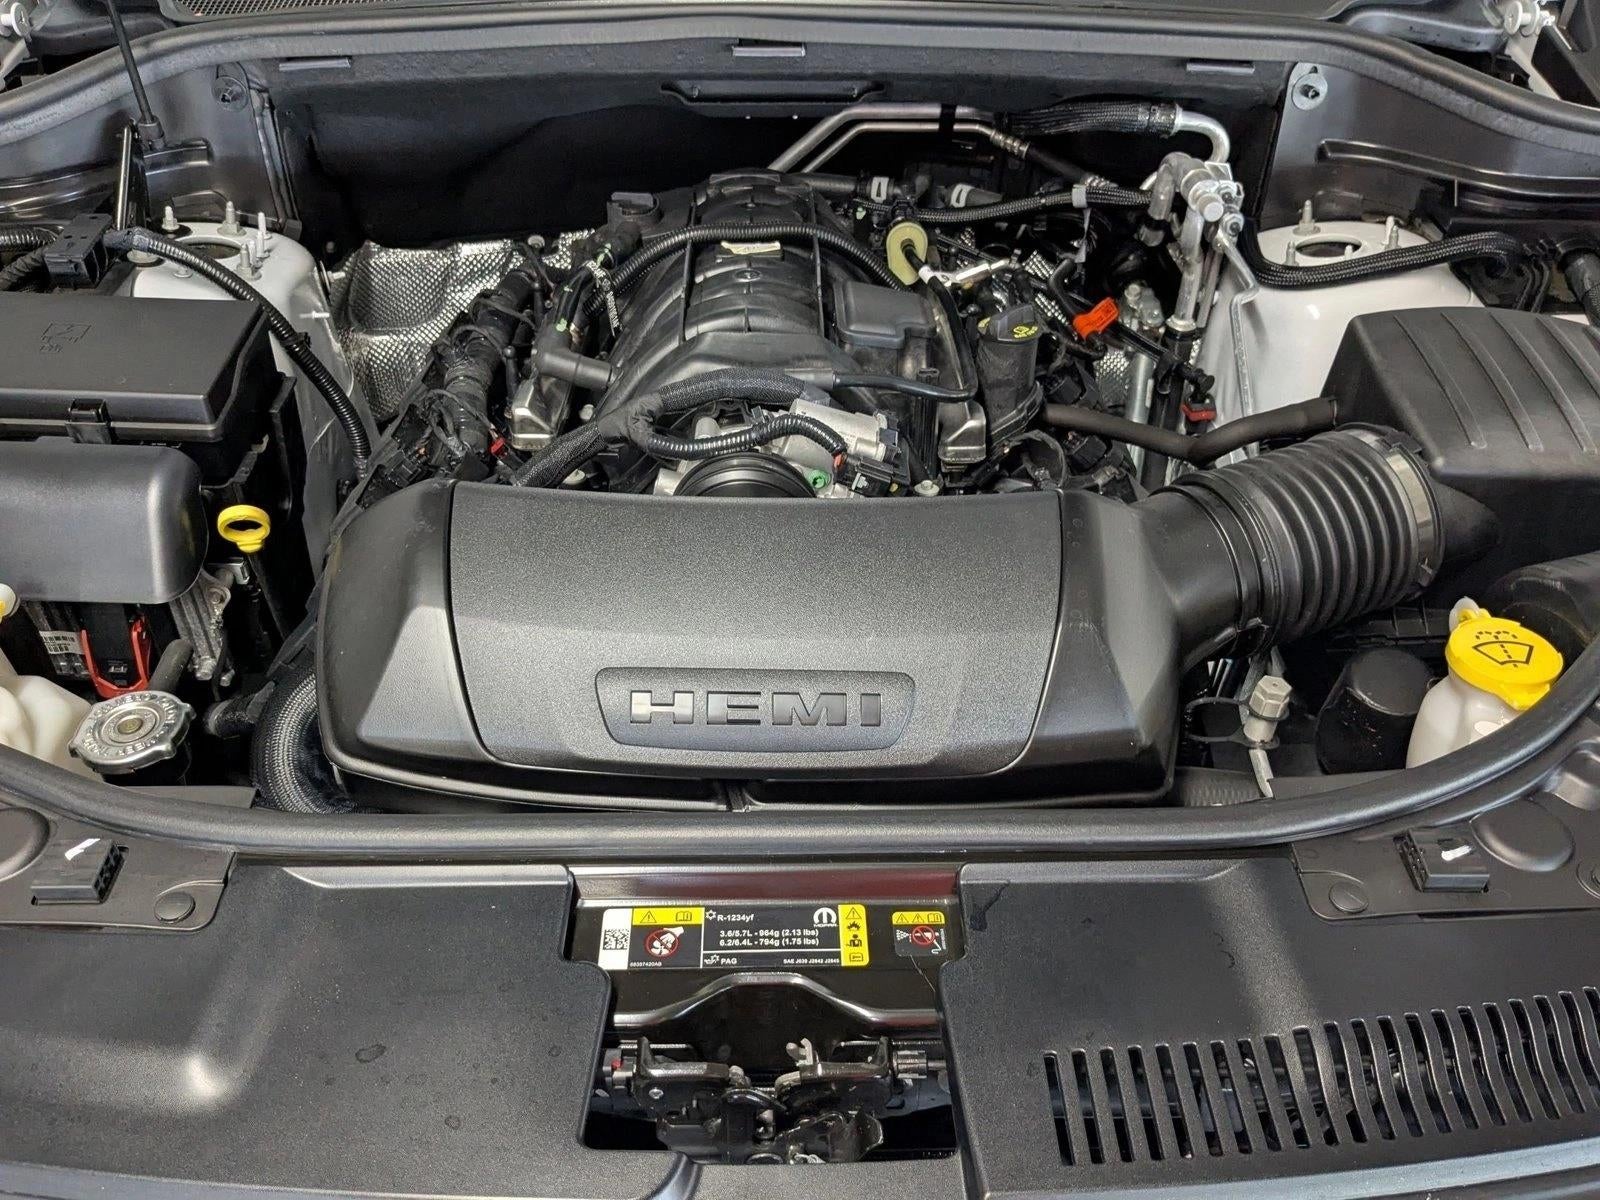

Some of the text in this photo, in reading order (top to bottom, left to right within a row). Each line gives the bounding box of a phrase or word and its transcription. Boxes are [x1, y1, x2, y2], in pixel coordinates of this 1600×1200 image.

[630, 689, 882, 727] HEMI
[717, 913, 754, 922] R-1234yf
[781, 929, 802, 937] (2.13
[803, 929, 819, 937] lbs)
[758, 938, 780, 947] 794g
[803, 938, 819, 946] lbs)
